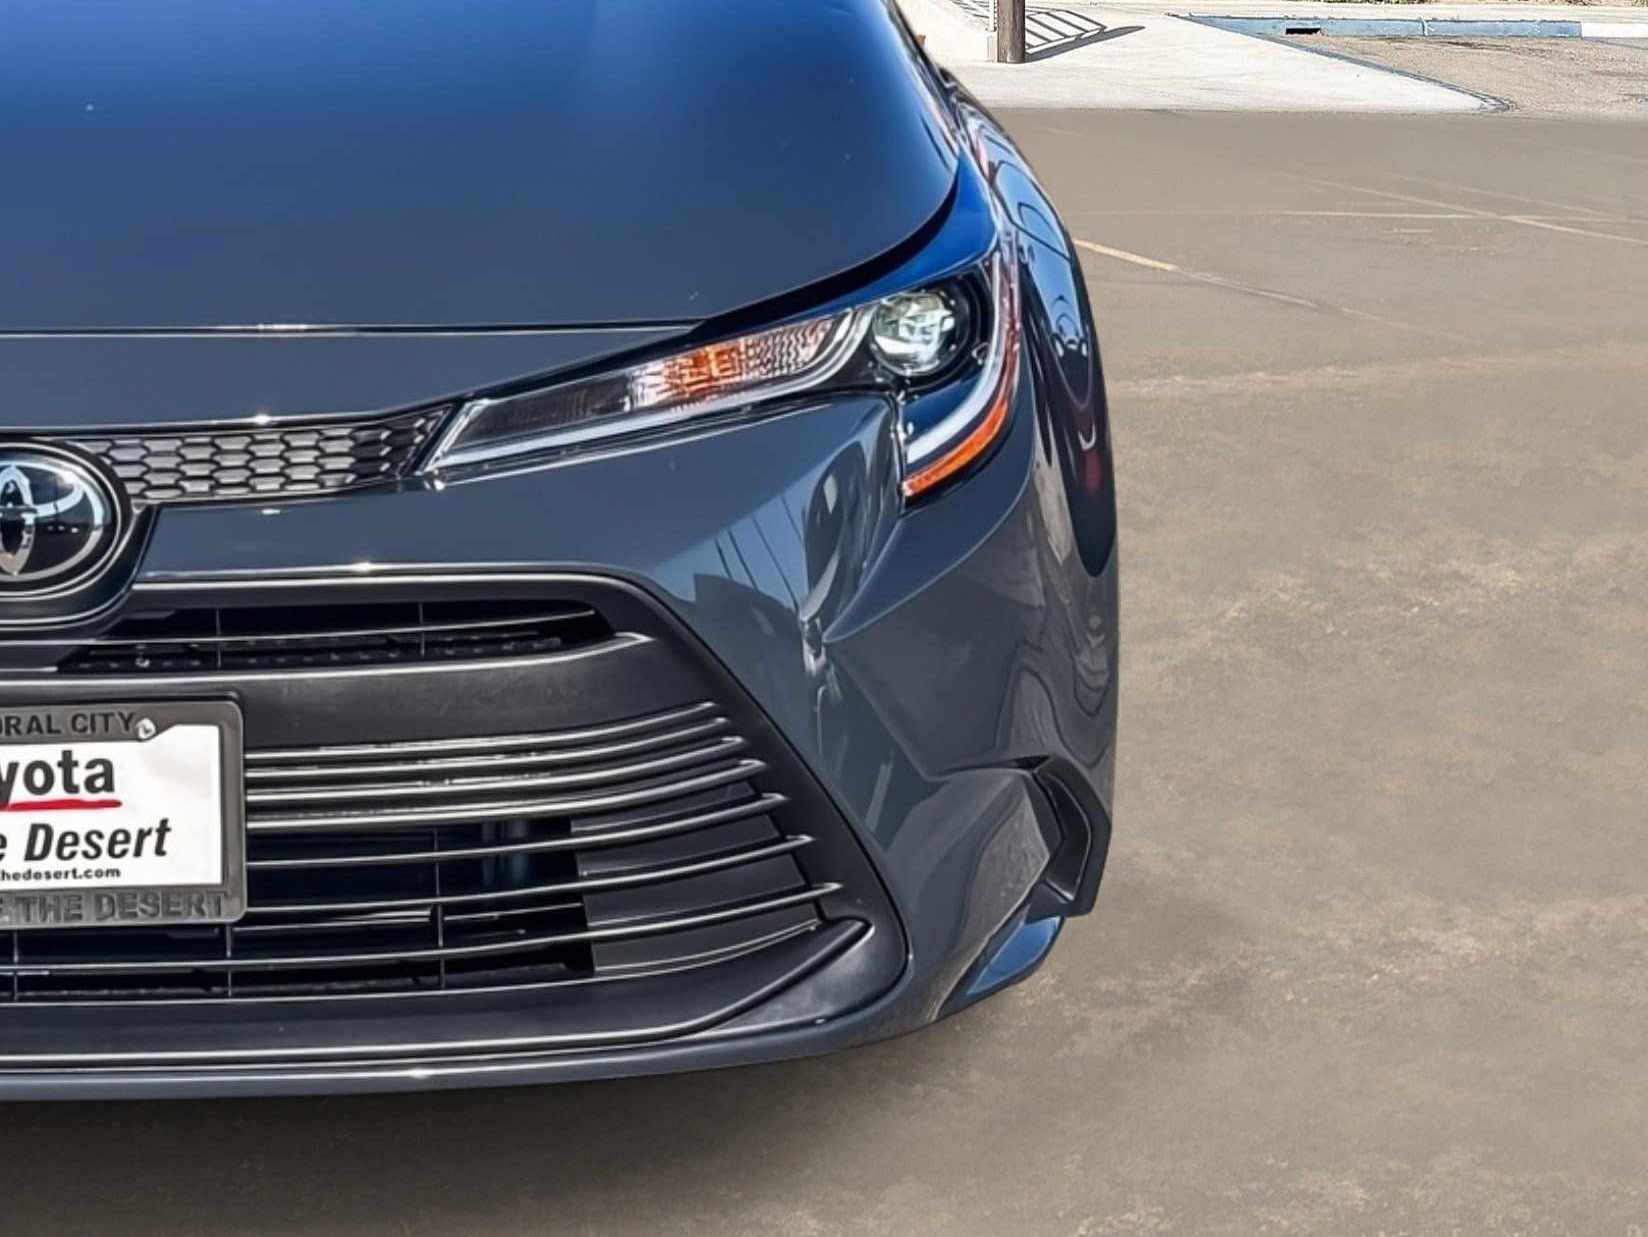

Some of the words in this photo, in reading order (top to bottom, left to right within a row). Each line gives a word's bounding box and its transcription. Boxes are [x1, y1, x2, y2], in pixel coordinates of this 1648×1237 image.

[70, 711, 136, 735] CITY
[24, 818, 172, 861] Desert
[13, 894, 83, 922] THE
[93, 890, 228, 919] DESERT
